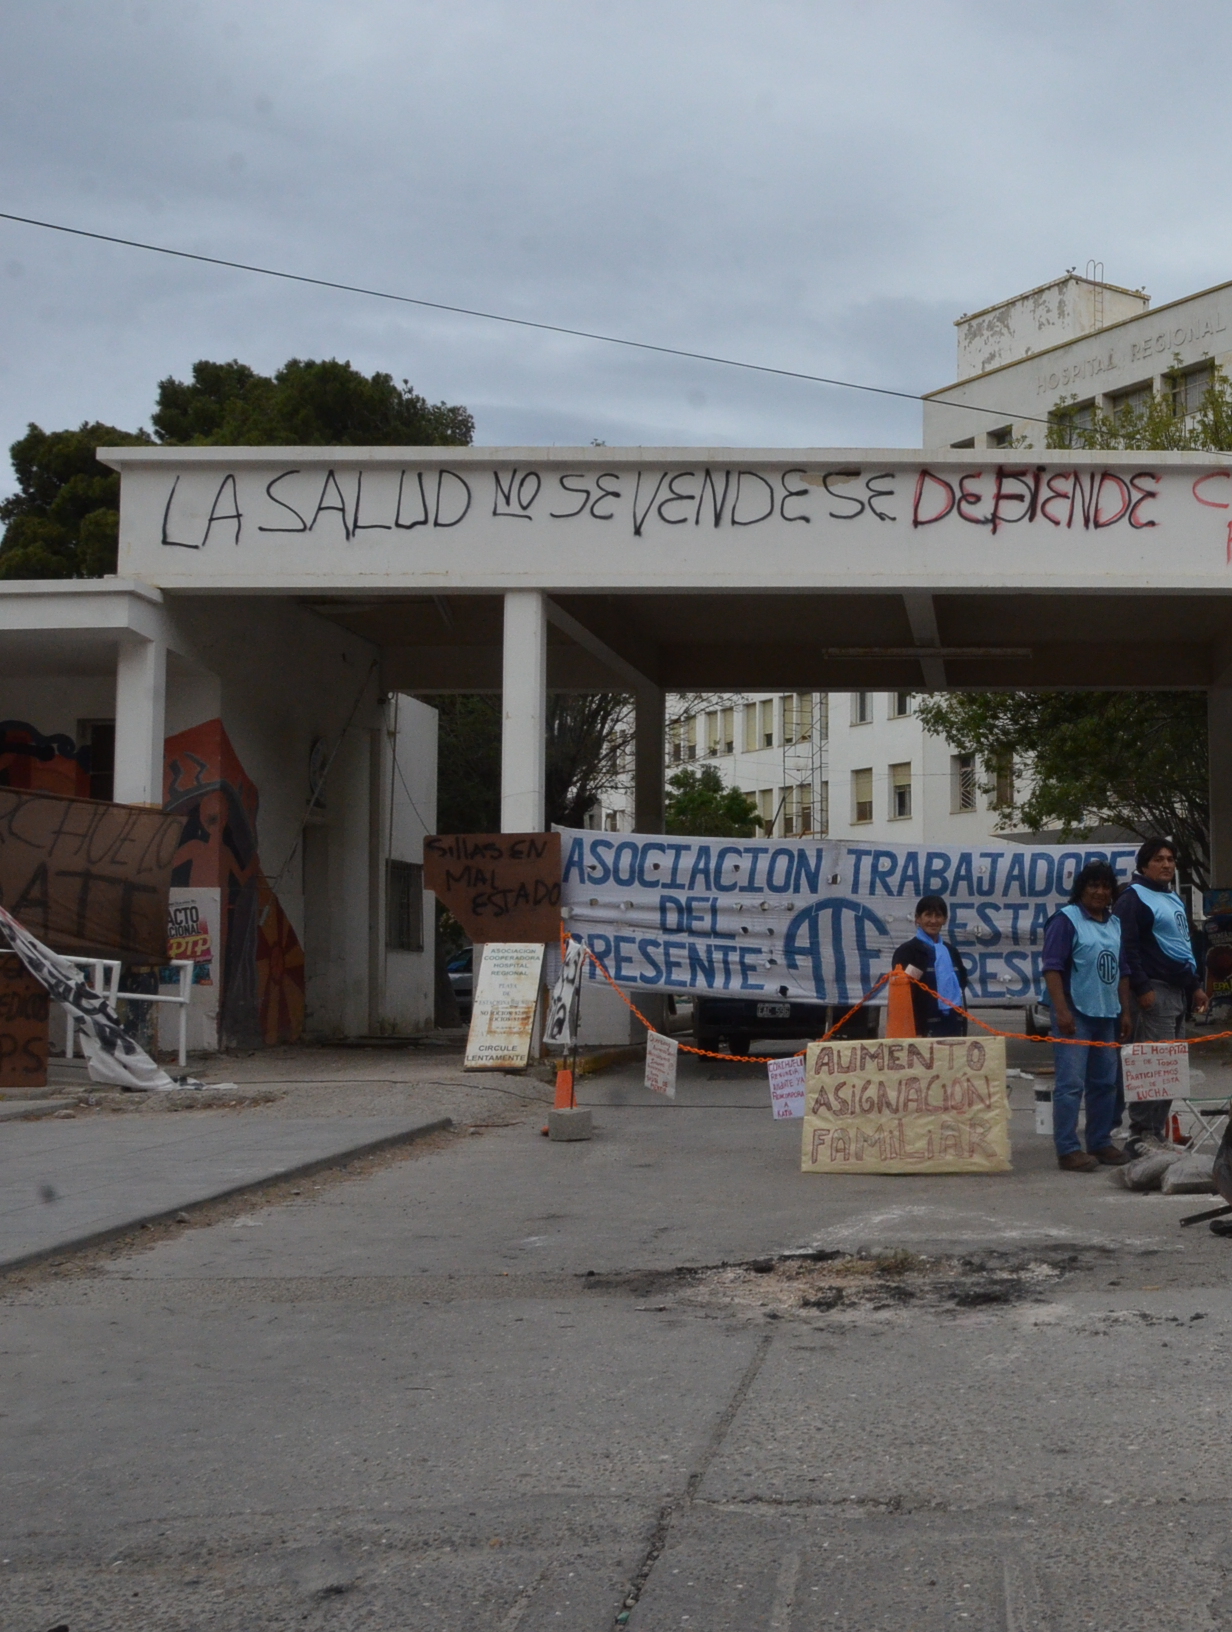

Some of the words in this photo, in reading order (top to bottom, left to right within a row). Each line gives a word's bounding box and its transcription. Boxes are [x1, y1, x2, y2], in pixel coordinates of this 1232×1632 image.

[1036, 348, 1118, 396] HOSPITAL
[1130, 312, 1227, 363] REGIONAL
[160, 473, 243, 549] LA
[257, 469, 473, 542] SALUD
[491, 468, 542, 520] NO
[549, 473, 622, 520] SE
[632, 468, 811, 537] VENDE
[822, 467, 897, 522] SE
[510, 838, 548, 860] EN
[562, 837, 823, 895] ASOCIACION
[446, 865, 498, 891] MAL
[472, 879, 561, 917] ESTADO
[659, 894, 736, 940] DEL
[948, 902, 1062, 948] ESTA
[169, 934, 212, 958] PTP
[1098, 952, 1117, 982] ATE
[814, 1040, 986, 1076] AUMENTO
[1131, 1044, 1148, 1056] EL
